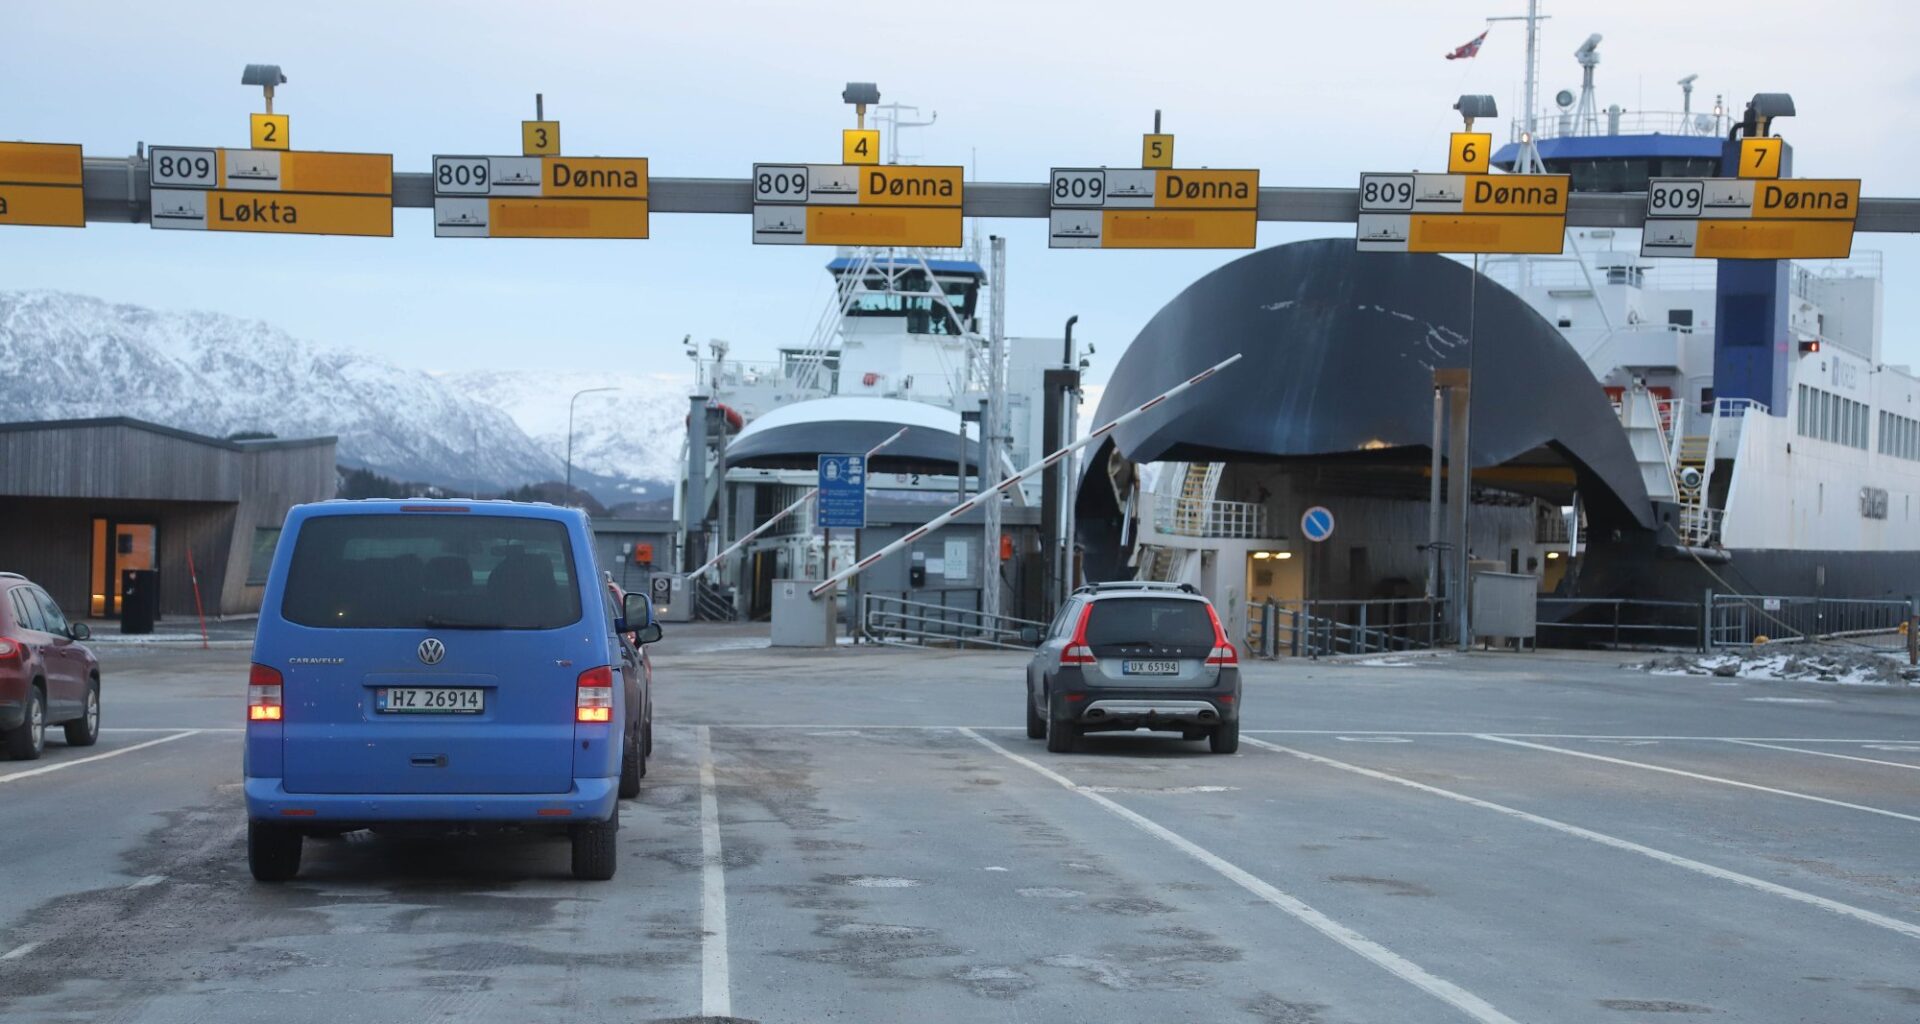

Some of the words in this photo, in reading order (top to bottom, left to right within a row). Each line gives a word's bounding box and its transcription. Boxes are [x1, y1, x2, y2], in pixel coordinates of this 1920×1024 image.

[263, 123, 277, 142] 2
[535, 129, 548, 148] 3
[853, 138, 869, 157] 4
[1151, 141, 1163, 160] 5
[1461, 142, 1476, 163] 6
[158, 156, 210, 179] 809
[1754, 148, 1768, 168] 7
[438, 165, 487, 187] 809
[553, 164, 639, 189] Dønna
[757, 173, 807, 195] 809
[870, 172, 954, 197] Dønna
[1055, 177, 1103, 199] 809
[1166, 176, 1249, 200] Dønna
[1364, 182, 1412, 204] 809
[1474, 180, 1558, 205] Dønna
[1652, 188, 1701, 210] 809
[1764, 186, 1849, 210] Dønna
[219, 197, 299, 226] Løkta
[911, 474, 920, 486] 2
[1130, 662, 1145, 673] UX
[1148, 662, 1177, 673] 65194
[393, 690, 417, 707] HZ
[424, 691, 478, 708] 26914
